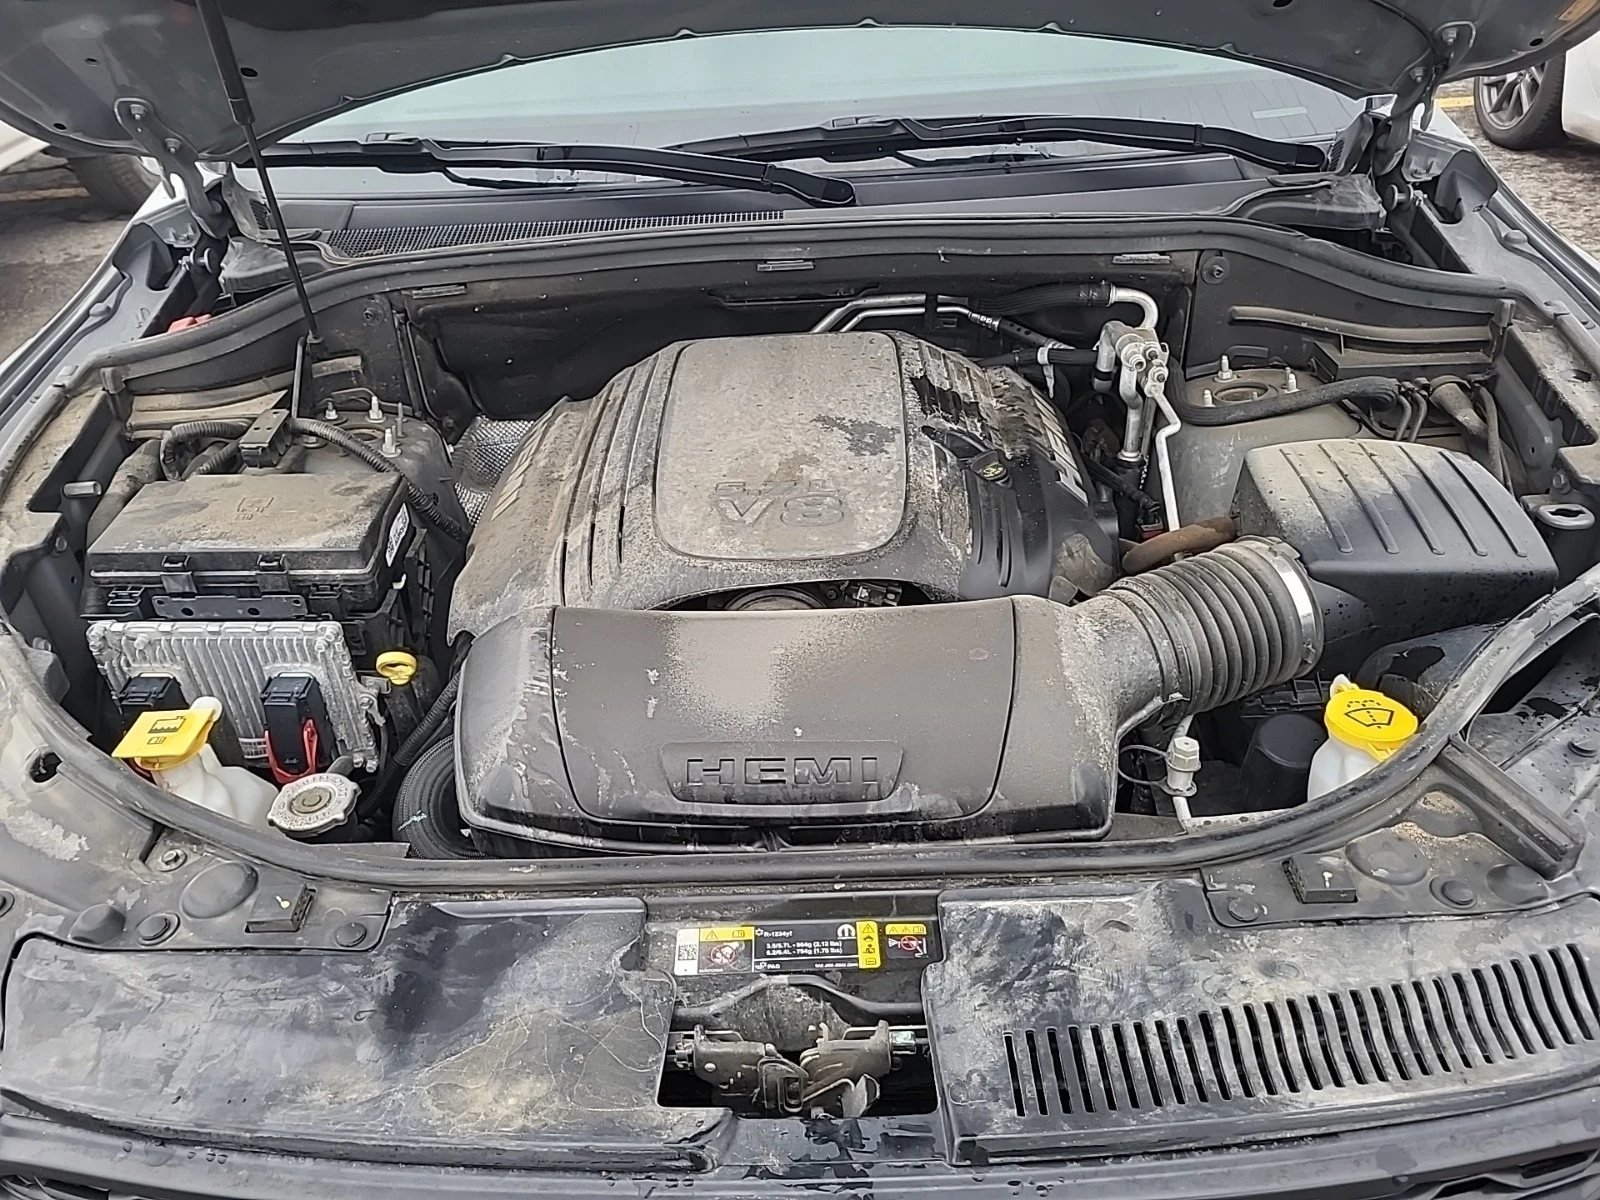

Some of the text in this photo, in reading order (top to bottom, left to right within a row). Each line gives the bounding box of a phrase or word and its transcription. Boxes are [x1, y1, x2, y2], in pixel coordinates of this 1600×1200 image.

[1030, 387, 1089, 507] HEMI
[714, 495, 844, 527] V8
[686, 757, 878, 786] HEMI
[763, 930, 793, 938] R-1234yf
